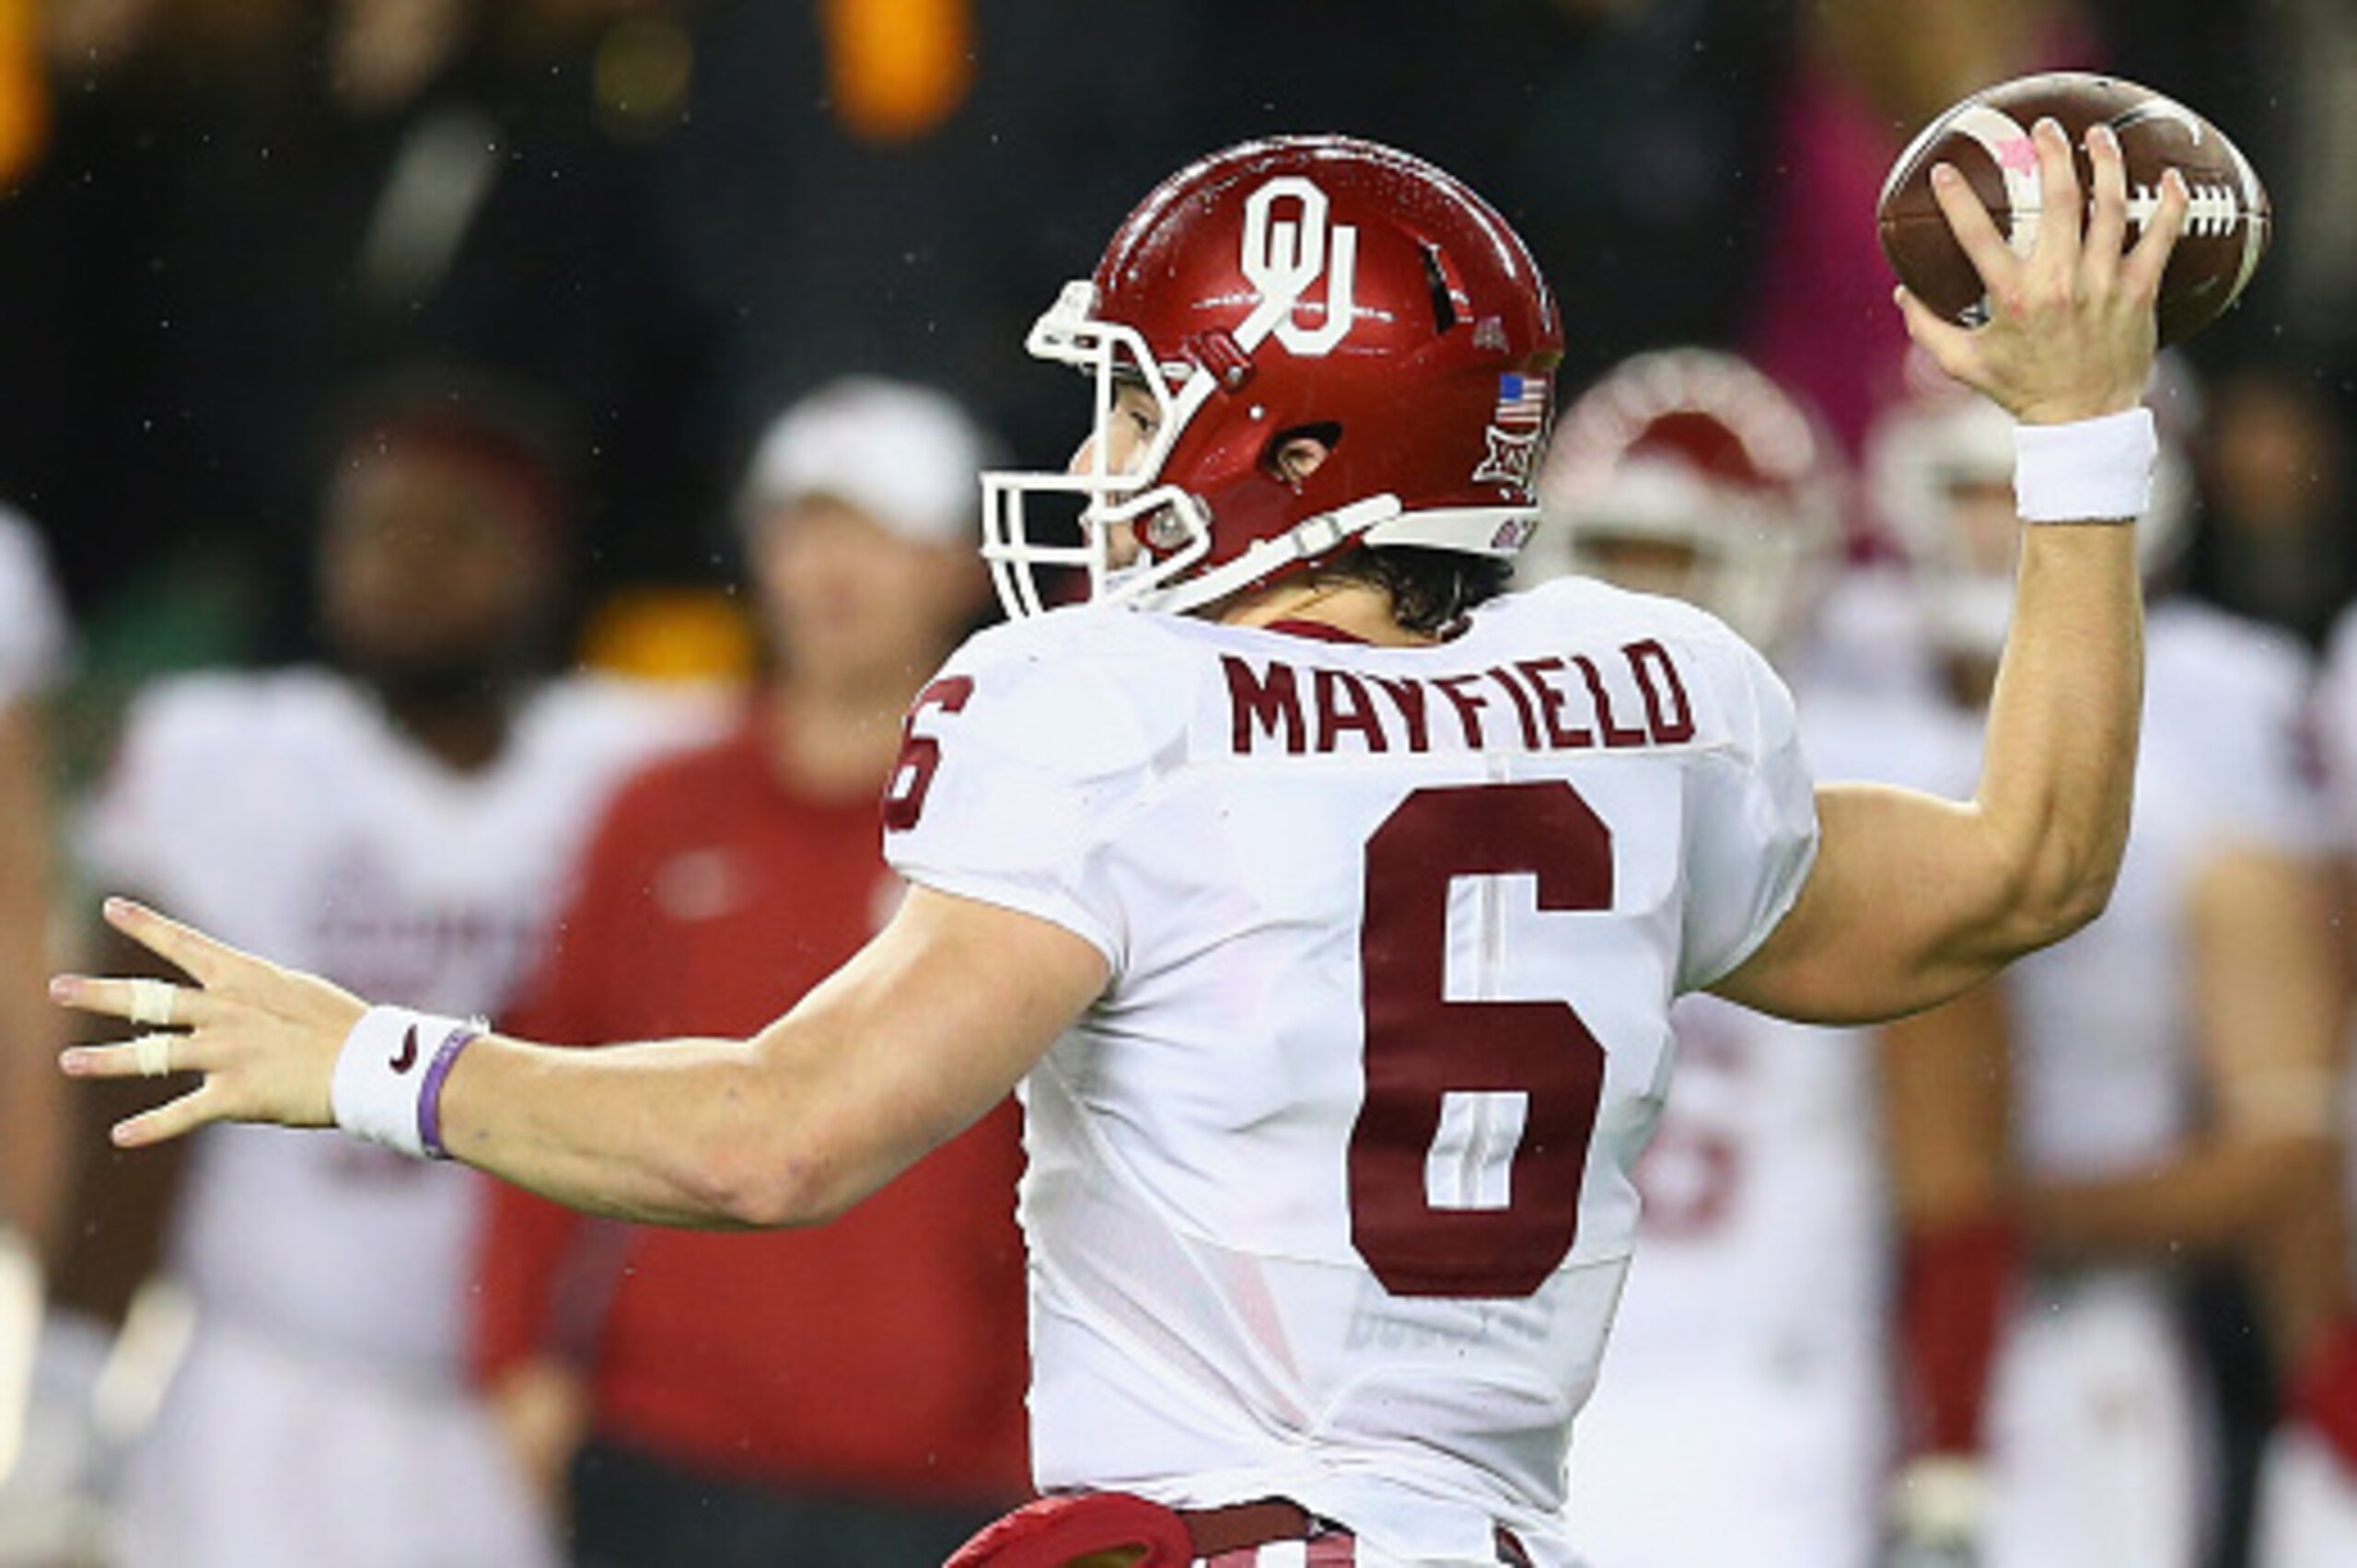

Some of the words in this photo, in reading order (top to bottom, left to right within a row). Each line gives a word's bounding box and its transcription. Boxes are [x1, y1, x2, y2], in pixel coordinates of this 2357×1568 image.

[1233, 175, 1357, 356] OU
[881, 676, 974, 832] 6
[1220, 638, 1696, 754] MAYFIELD
[1346, 780, 1614, 1300] 6
